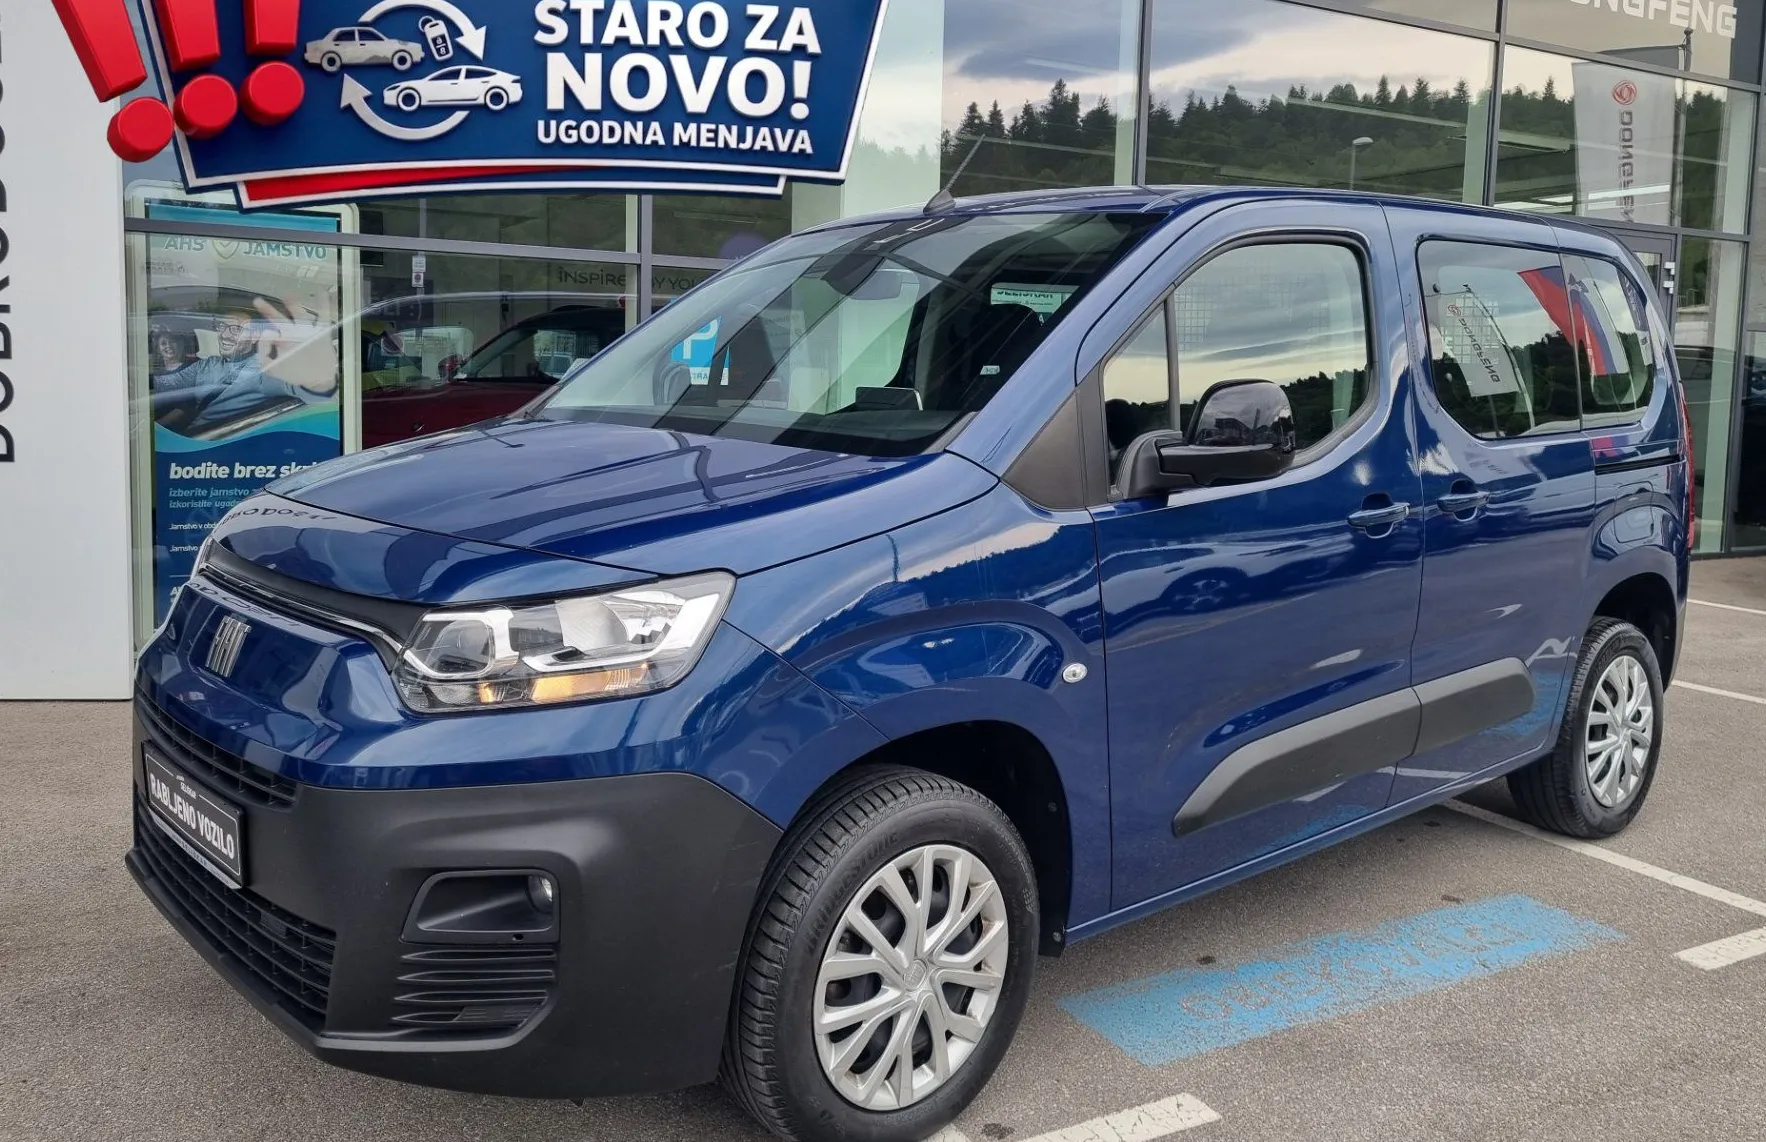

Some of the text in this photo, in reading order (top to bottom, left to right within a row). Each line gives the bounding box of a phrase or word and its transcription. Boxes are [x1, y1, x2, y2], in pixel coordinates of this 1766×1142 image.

[243, 241, 327, 259] JAMSTVO
[169, 461, 230, 479] bodite
[233, 461, 277, 479] brez
[169, 487, 250, 499] izberite jamstvo
[169, 499, 213, 509] izkoristite
[168, 522, 198, 530] Jamstvo
[150, 772, 197, 830] RABLJENO
[196, 810, 235, 860] VOZILO
